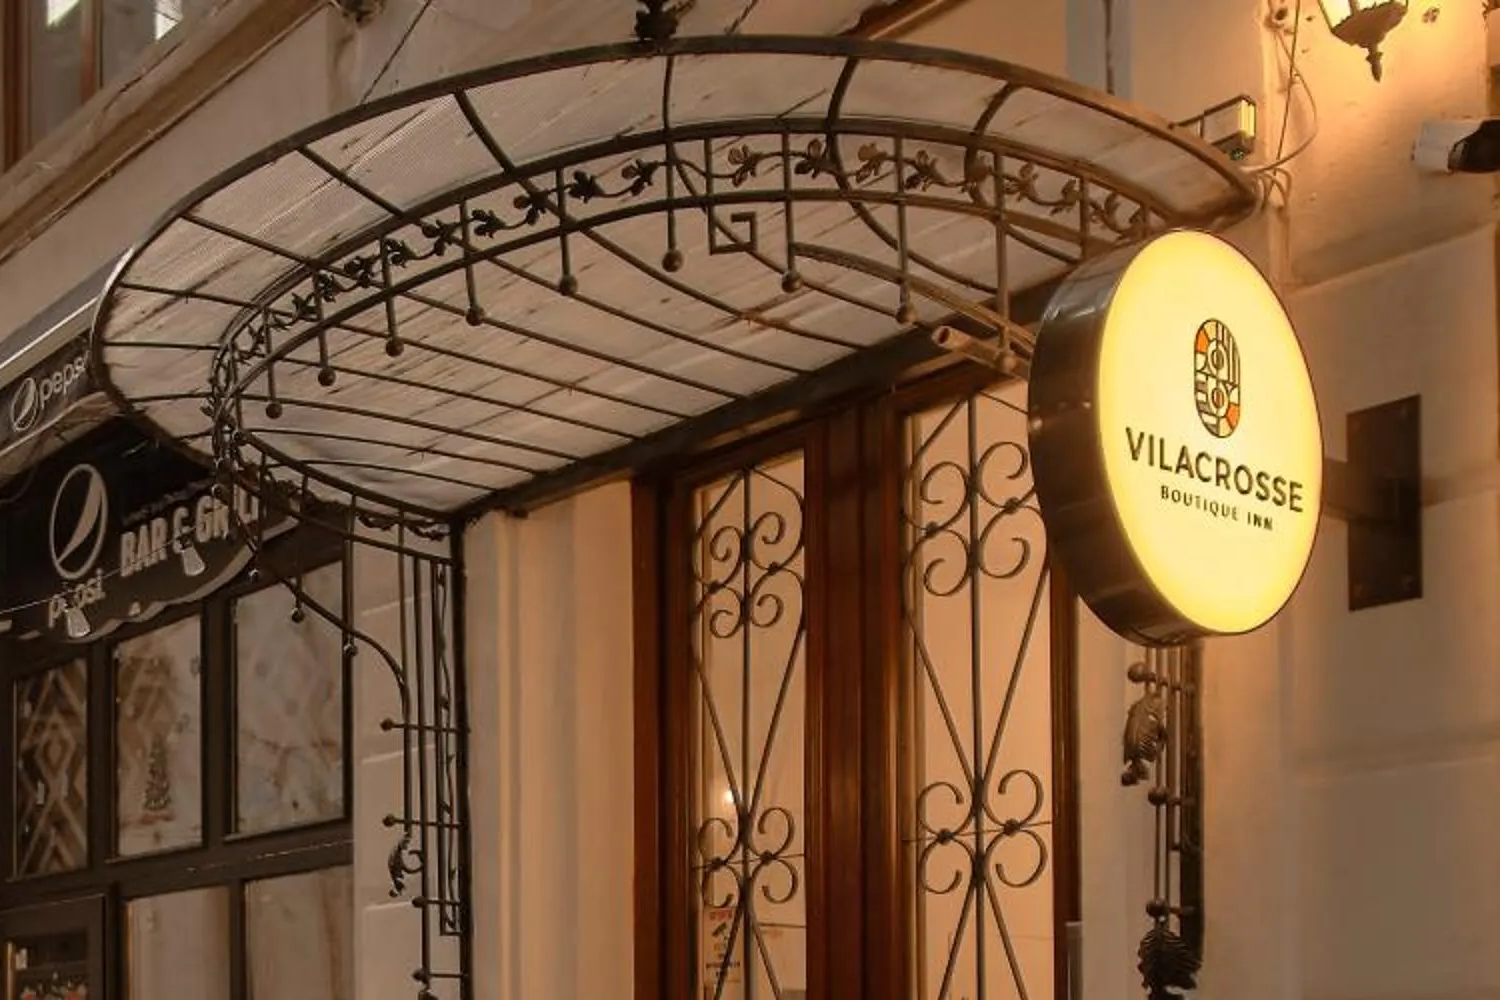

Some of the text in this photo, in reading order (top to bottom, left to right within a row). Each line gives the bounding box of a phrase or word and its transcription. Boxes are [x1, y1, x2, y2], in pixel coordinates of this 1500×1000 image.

[1125, 426, 1304, 513] VILACROSSE
[1160, 484, 1273, 531] BOUTIQUE INN
[121, 517, 168, 577] BAR
